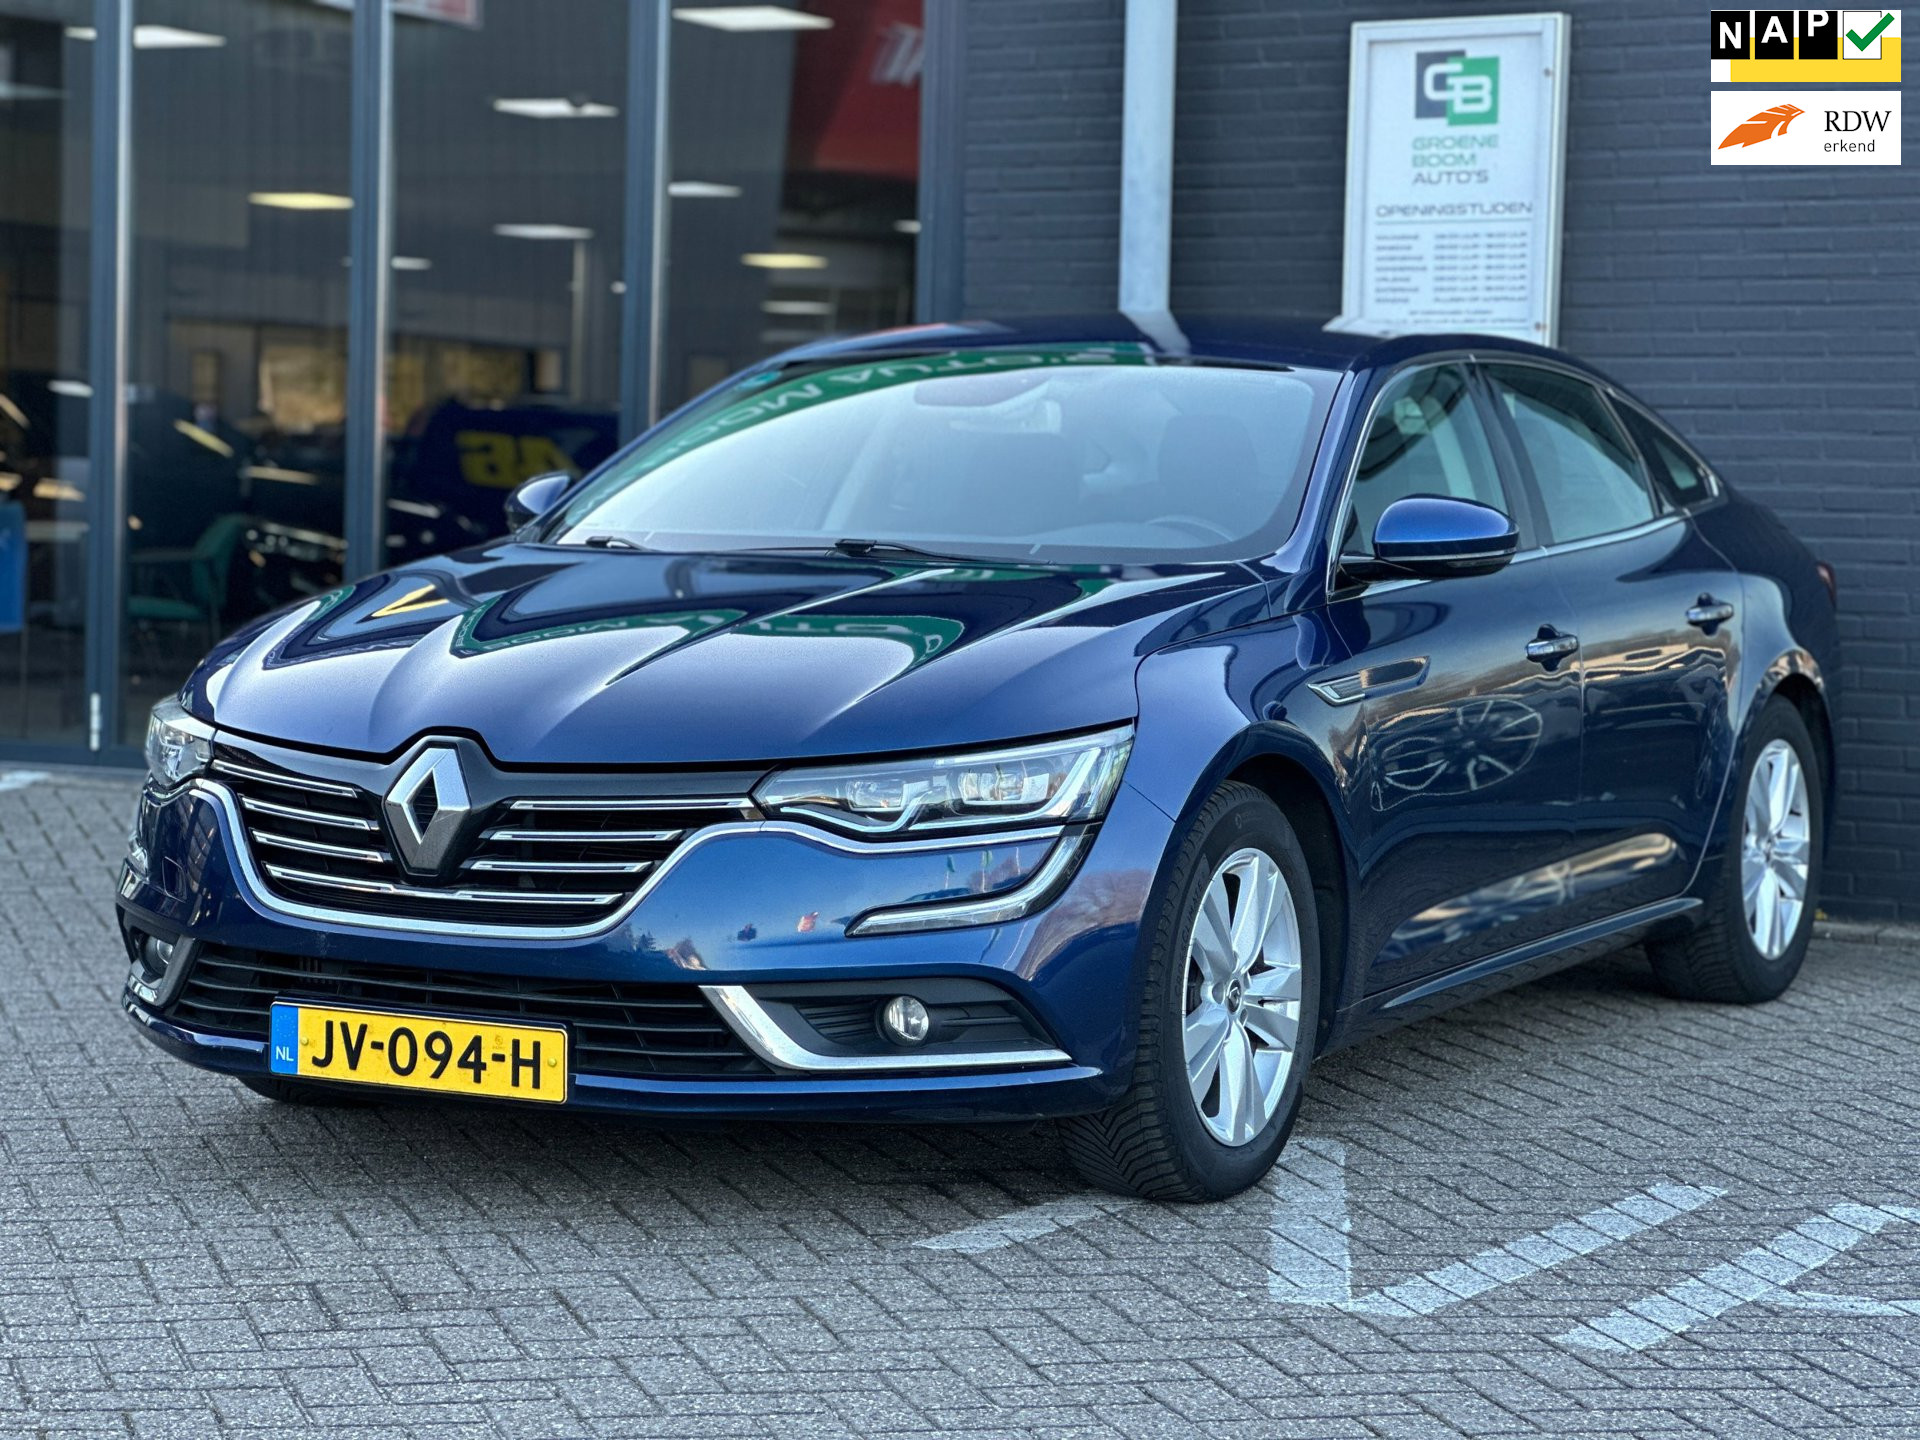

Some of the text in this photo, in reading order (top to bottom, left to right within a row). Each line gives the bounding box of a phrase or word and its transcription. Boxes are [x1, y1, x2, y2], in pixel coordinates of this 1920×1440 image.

[1411, 133, 1499, 150] GROENE
[1411, 152, 1477, 168] BOOM
[1411, 169, 1489, 185] AUTO'S
[275, 1045, 294, 1062] NL
[312, 1020, 541, 1089] JV-094-H
